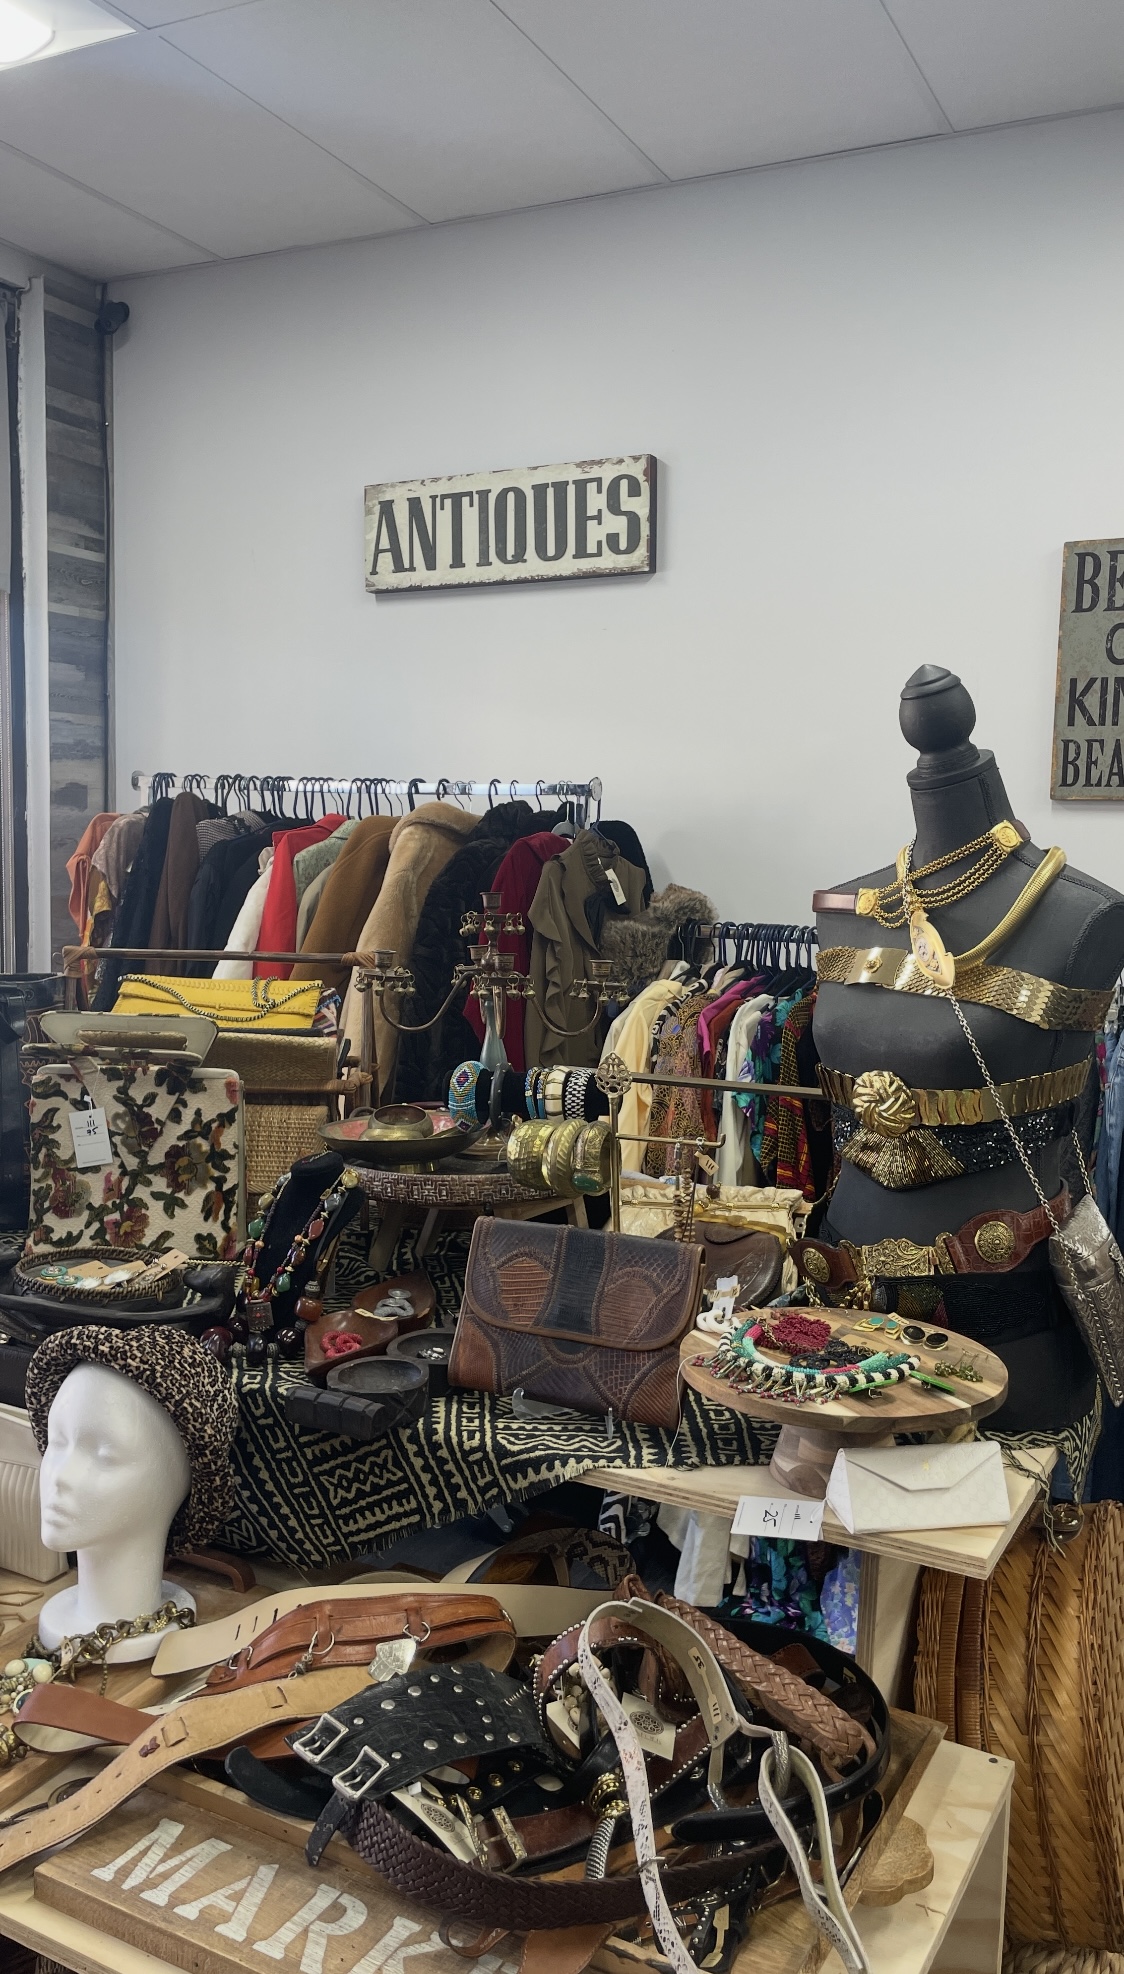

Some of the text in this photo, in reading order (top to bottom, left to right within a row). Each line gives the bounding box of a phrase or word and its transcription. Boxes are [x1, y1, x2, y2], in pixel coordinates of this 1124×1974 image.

[369, 473, 642, 576] ANTIQUES
[762, 1509, 779, 1528] 25
[90, 1818, 521, 1974] MARK
